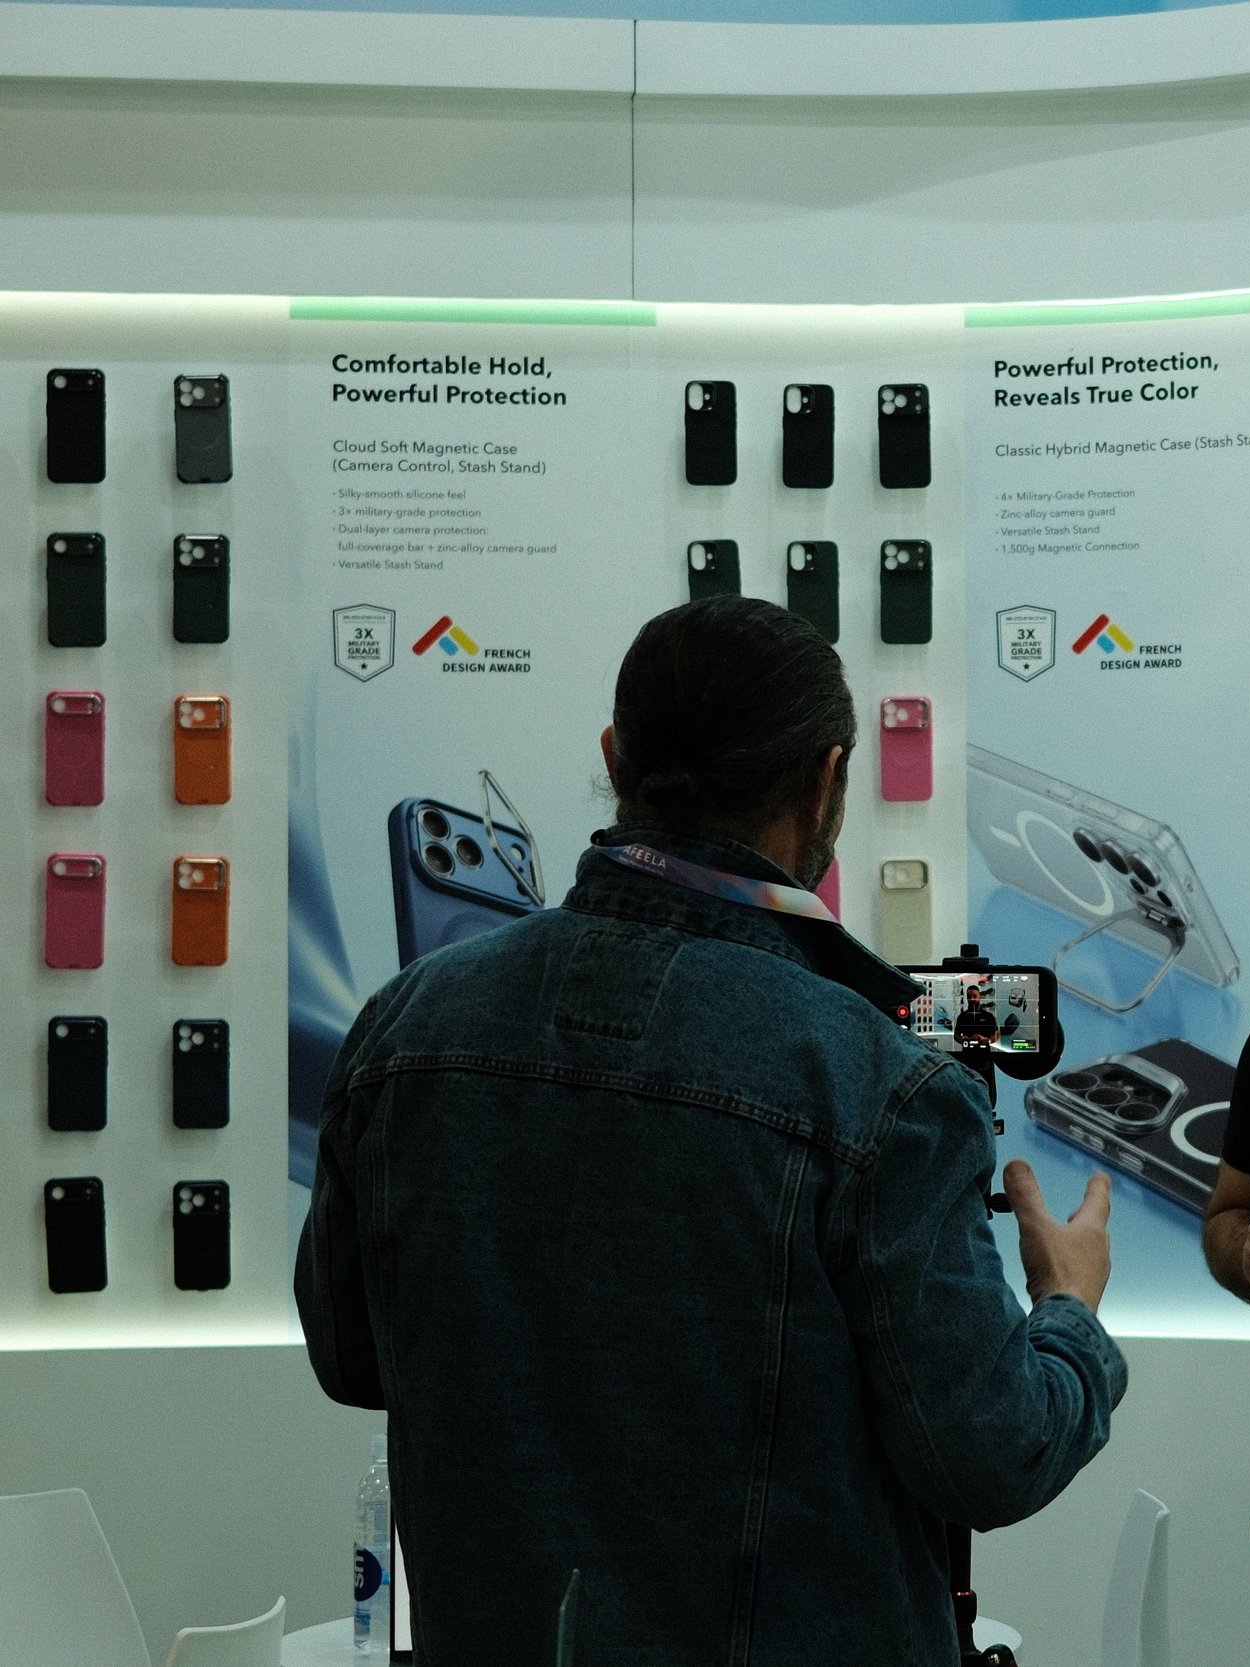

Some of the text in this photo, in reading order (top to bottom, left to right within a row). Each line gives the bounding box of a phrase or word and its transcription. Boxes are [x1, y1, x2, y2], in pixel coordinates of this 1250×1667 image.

[332, 354, 552, 378] Comfortable Hold,
[994, 352, 1218, 378] Powerful Protection,
[332, 384, 566, 406] Powerful Protection
[994, 381, 1199, 407] Reveals True Color
[333, 440, 518, 457] Cloud Soft Magnetic Case
[996, 444, 1041, 458] Classic
[1046, 442, 1090, 458] Hybrid
[1095, 440, 1156, 456] Magnetic
[1160, 437, 1191, 451] Case
[1195, 434, 1233, 450] (Stash
[333, 459, 546, 475] (Camera Control, Stash Stand)
[339, 489, 466, 500] Silky-smooth silicone feel
[1017, 491, 1085, 502] Military-Grade
[1088, 490, 1135, 499] Protection
[355, 507, 426, 519] military-grade
[429, 508, 481, 519] protection
[1088, 507, 1115, 517] guard
[339, 524, 390, 537] Dual-layer
[393, 526, 430, 534] camera
[1001, 525, 1100, 536] Versatile Stash Stand
[338, 543, 404, 554] full-coverage
[408, 543, 424, 552] bar
[437, 544, 484, 555] zinc-alloy
[487, 545, 524, 553] camera
[527, 545, 557, 555] guard
[1038, 544, 1082, 554] Magnetic
[1085, 542, 1139, 551] Connection
[339, 560, 443, 570] Versatile Stash Stand
[355, 628, 374, 639] 3X
[1017, 629, 1035, 640] 3X
[348, 647, 380, 655] GRADE
[484, 649, 530, 659] FRENCH
[1139, 645, 1182, 655] FRENCH
[442, 663, 530, 673] DESIGN AWARD
[1101, 659, 1182, 670] DESIGN AWARD
[622, 846, 666, 869] AFEELA
